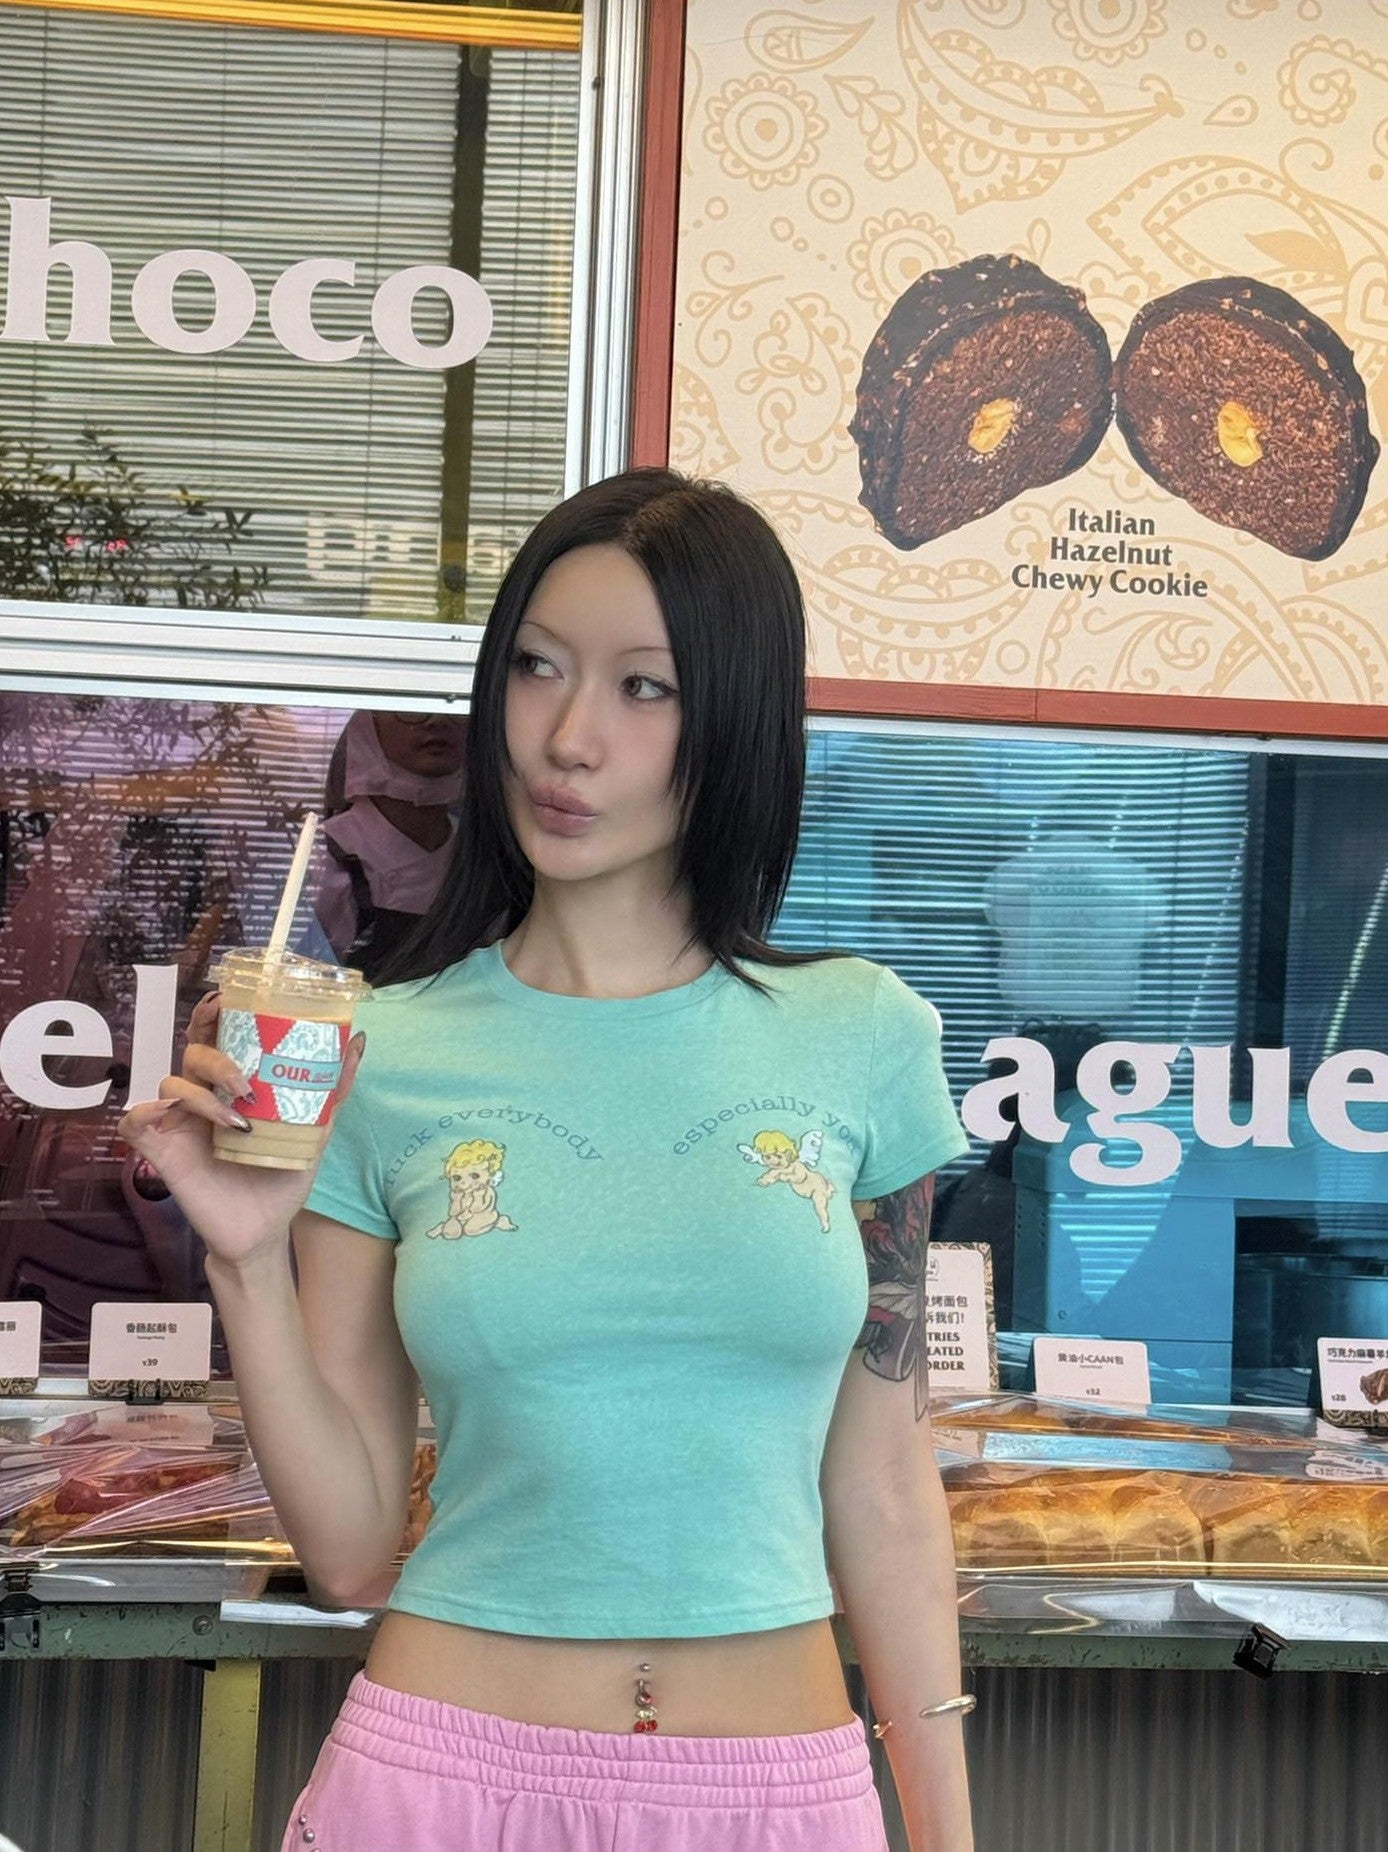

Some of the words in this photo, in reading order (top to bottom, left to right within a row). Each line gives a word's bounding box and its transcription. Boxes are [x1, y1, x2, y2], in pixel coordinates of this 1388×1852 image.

[0, 197, 493, 368] hoco
[1068, 508, 1155, 535] Italian
[1050, 537, 1173, 566] Hazelnut
[1012, 564, 1103, 598] Chewy
[1110, 569, 1208, 597] Cookie
[272, 1064, 311, 1082] OUR
[673, 1096, 816, 1155] especially
[961, 1037, 1388, 1186] ague
[438, 1105, 604, 1161] everybody
[927, 1332, 960, 1342] TRIES
